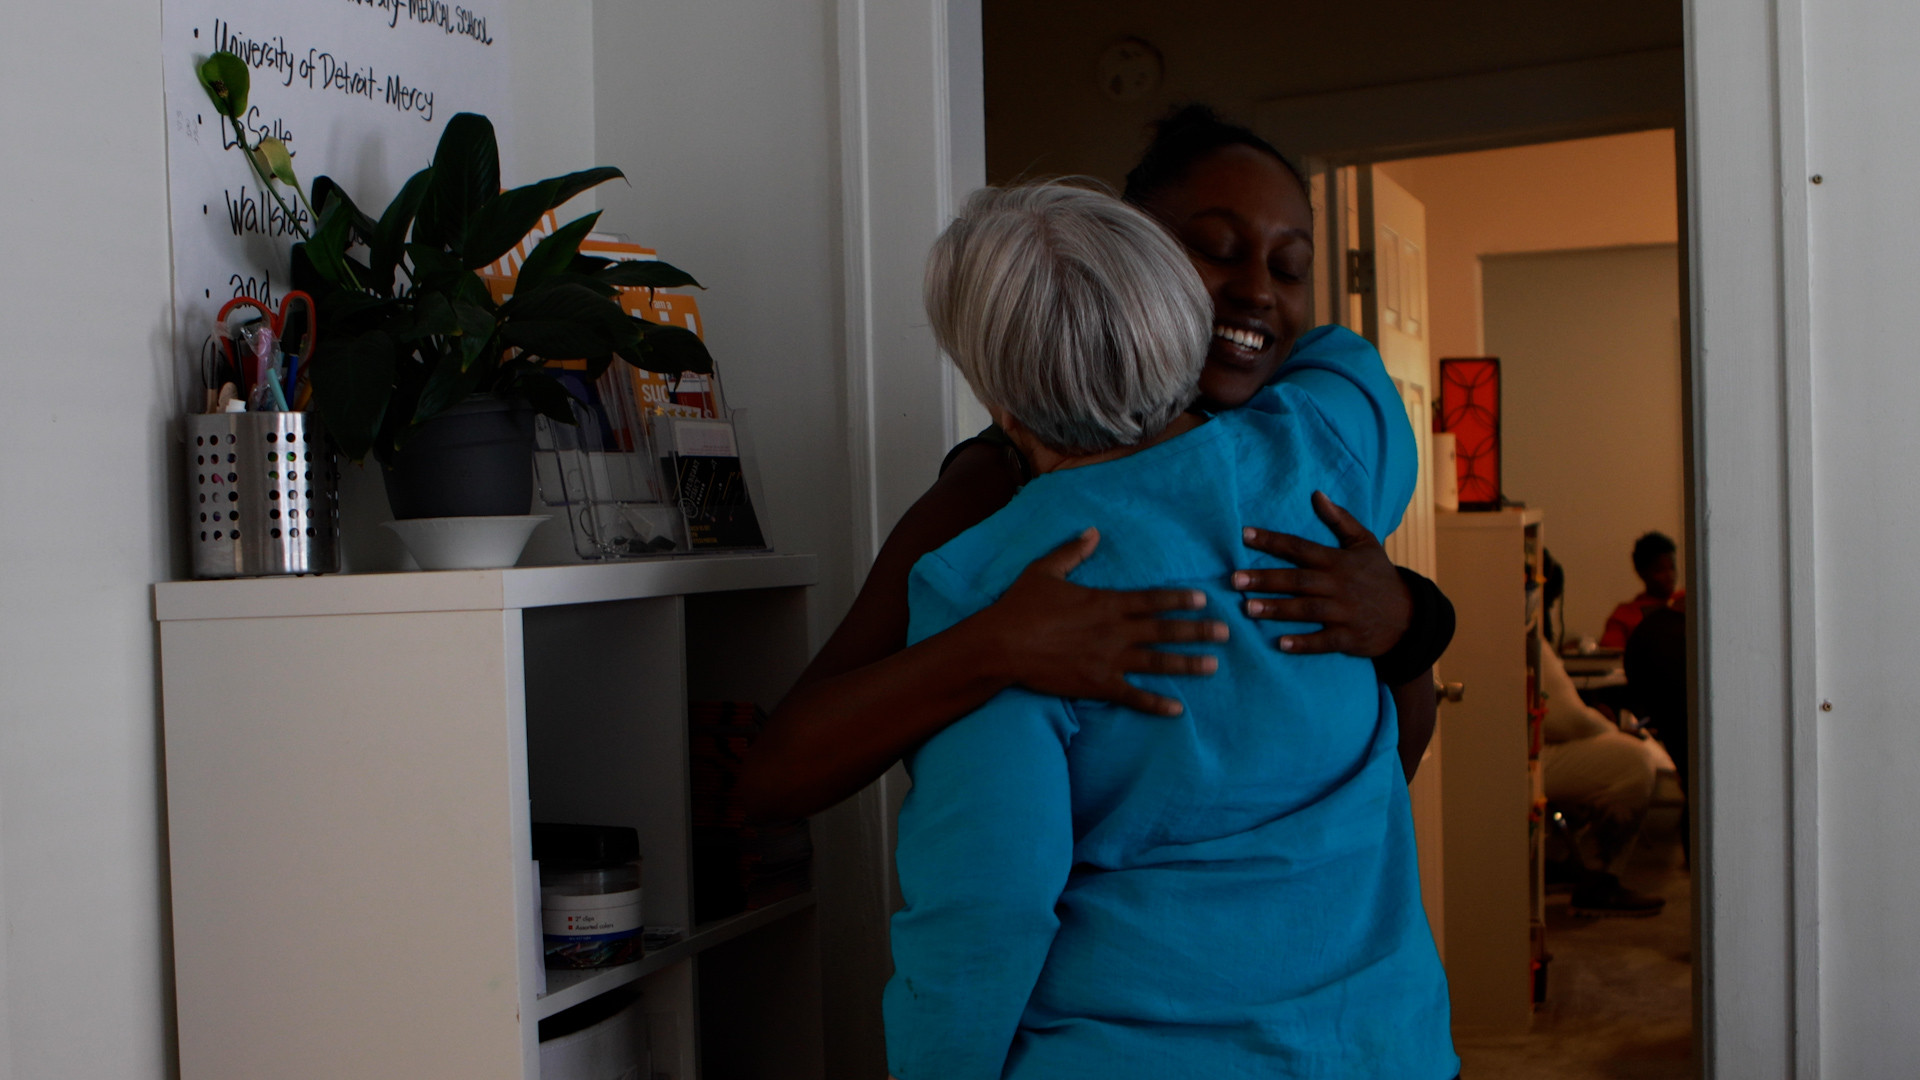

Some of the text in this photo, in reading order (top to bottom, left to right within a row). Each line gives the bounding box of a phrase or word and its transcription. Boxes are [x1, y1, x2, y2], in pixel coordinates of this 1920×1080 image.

[455, 5, 493, 45] SCHOOL
[214, 18, 294, 87] University
[299, 48, 317, 88] of
